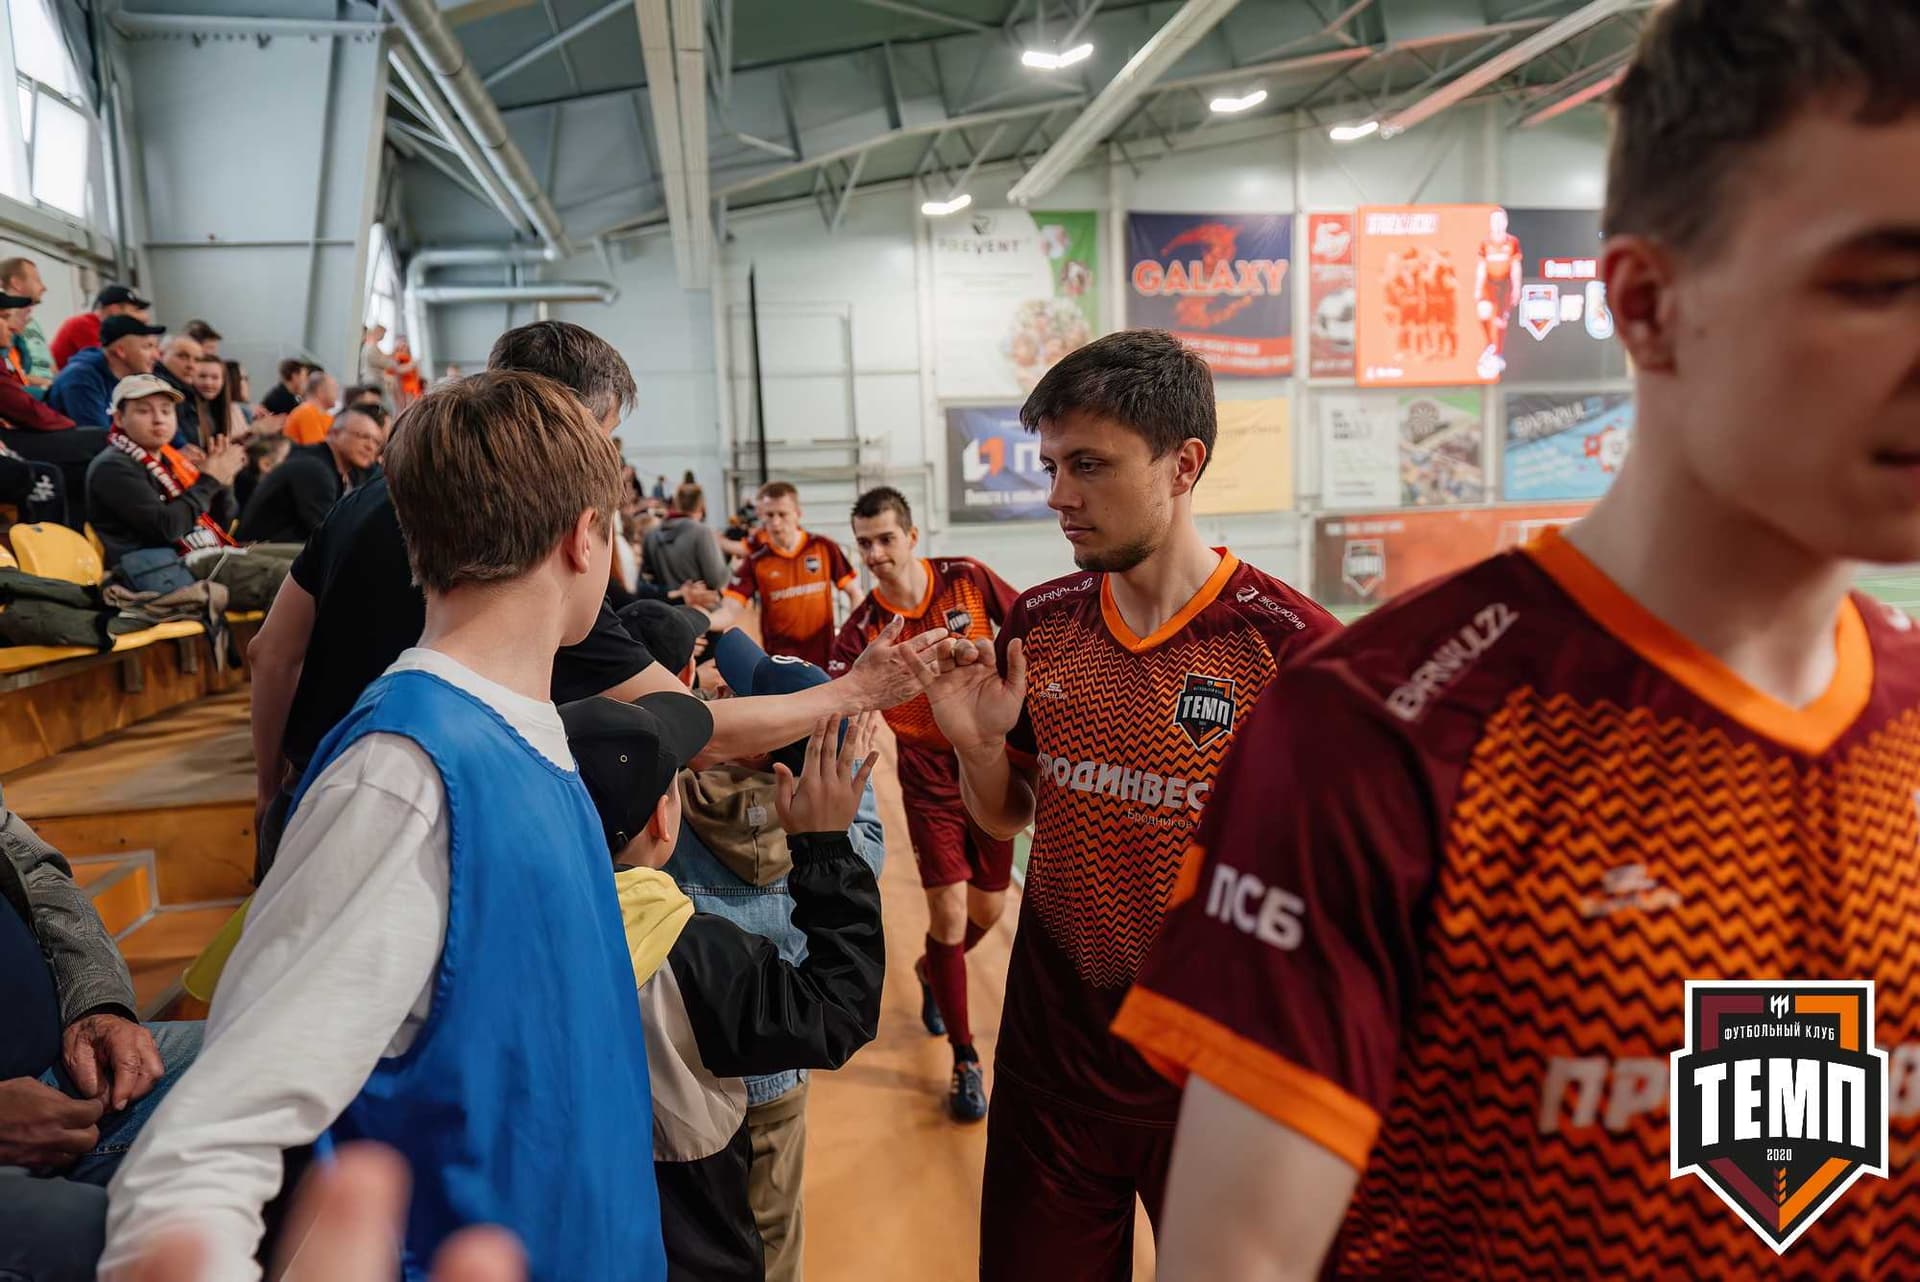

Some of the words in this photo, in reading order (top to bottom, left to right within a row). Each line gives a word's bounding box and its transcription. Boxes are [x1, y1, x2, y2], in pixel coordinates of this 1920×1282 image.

[1131, 258, 1290, 297] GALAXY
[1182, 695, 1231, 726] ТЕМП
[1037, 752, 1212, 811] РОДИНВЕС
[1205, 863, 1305, 951] ПСБ
